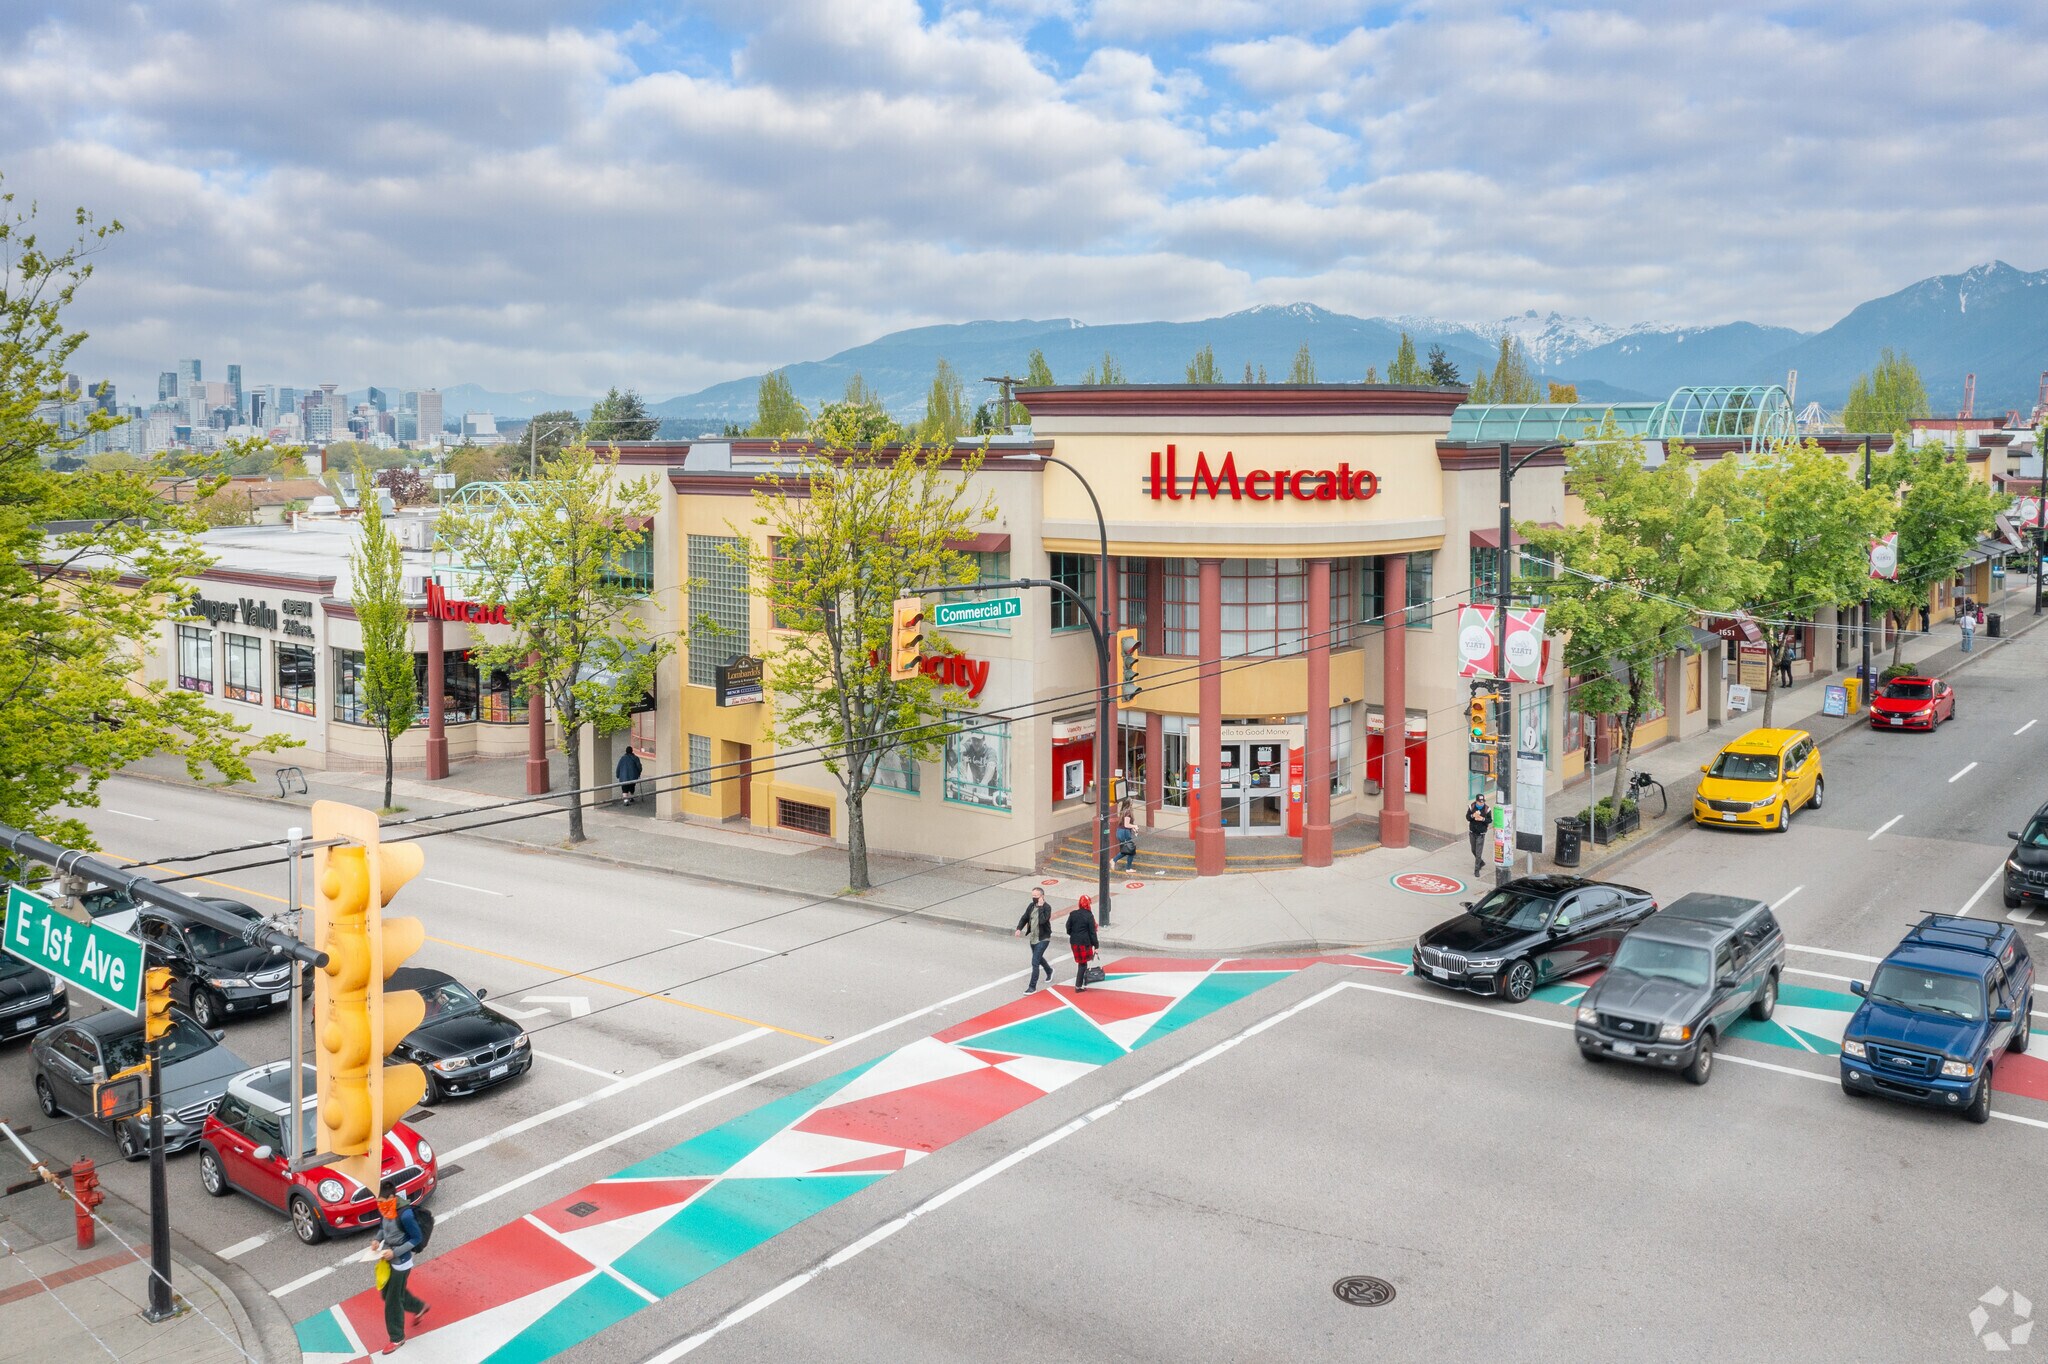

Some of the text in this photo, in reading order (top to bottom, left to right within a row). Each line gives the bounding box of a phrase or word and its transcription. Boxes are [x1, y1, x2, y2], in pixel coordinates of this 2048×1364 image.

[1150, 444, 1378, 502] Il Mercato
[190, 592, 238, 627] Super
[941, 601, 1017, 623] Commercial Dr
[1719, 628, 1736, 637] 1651
[1221, 729, 1235, 737] ello
[1245, 728, 1265, 736] Good
[16, 901, 126, 992] E 1st Ave
